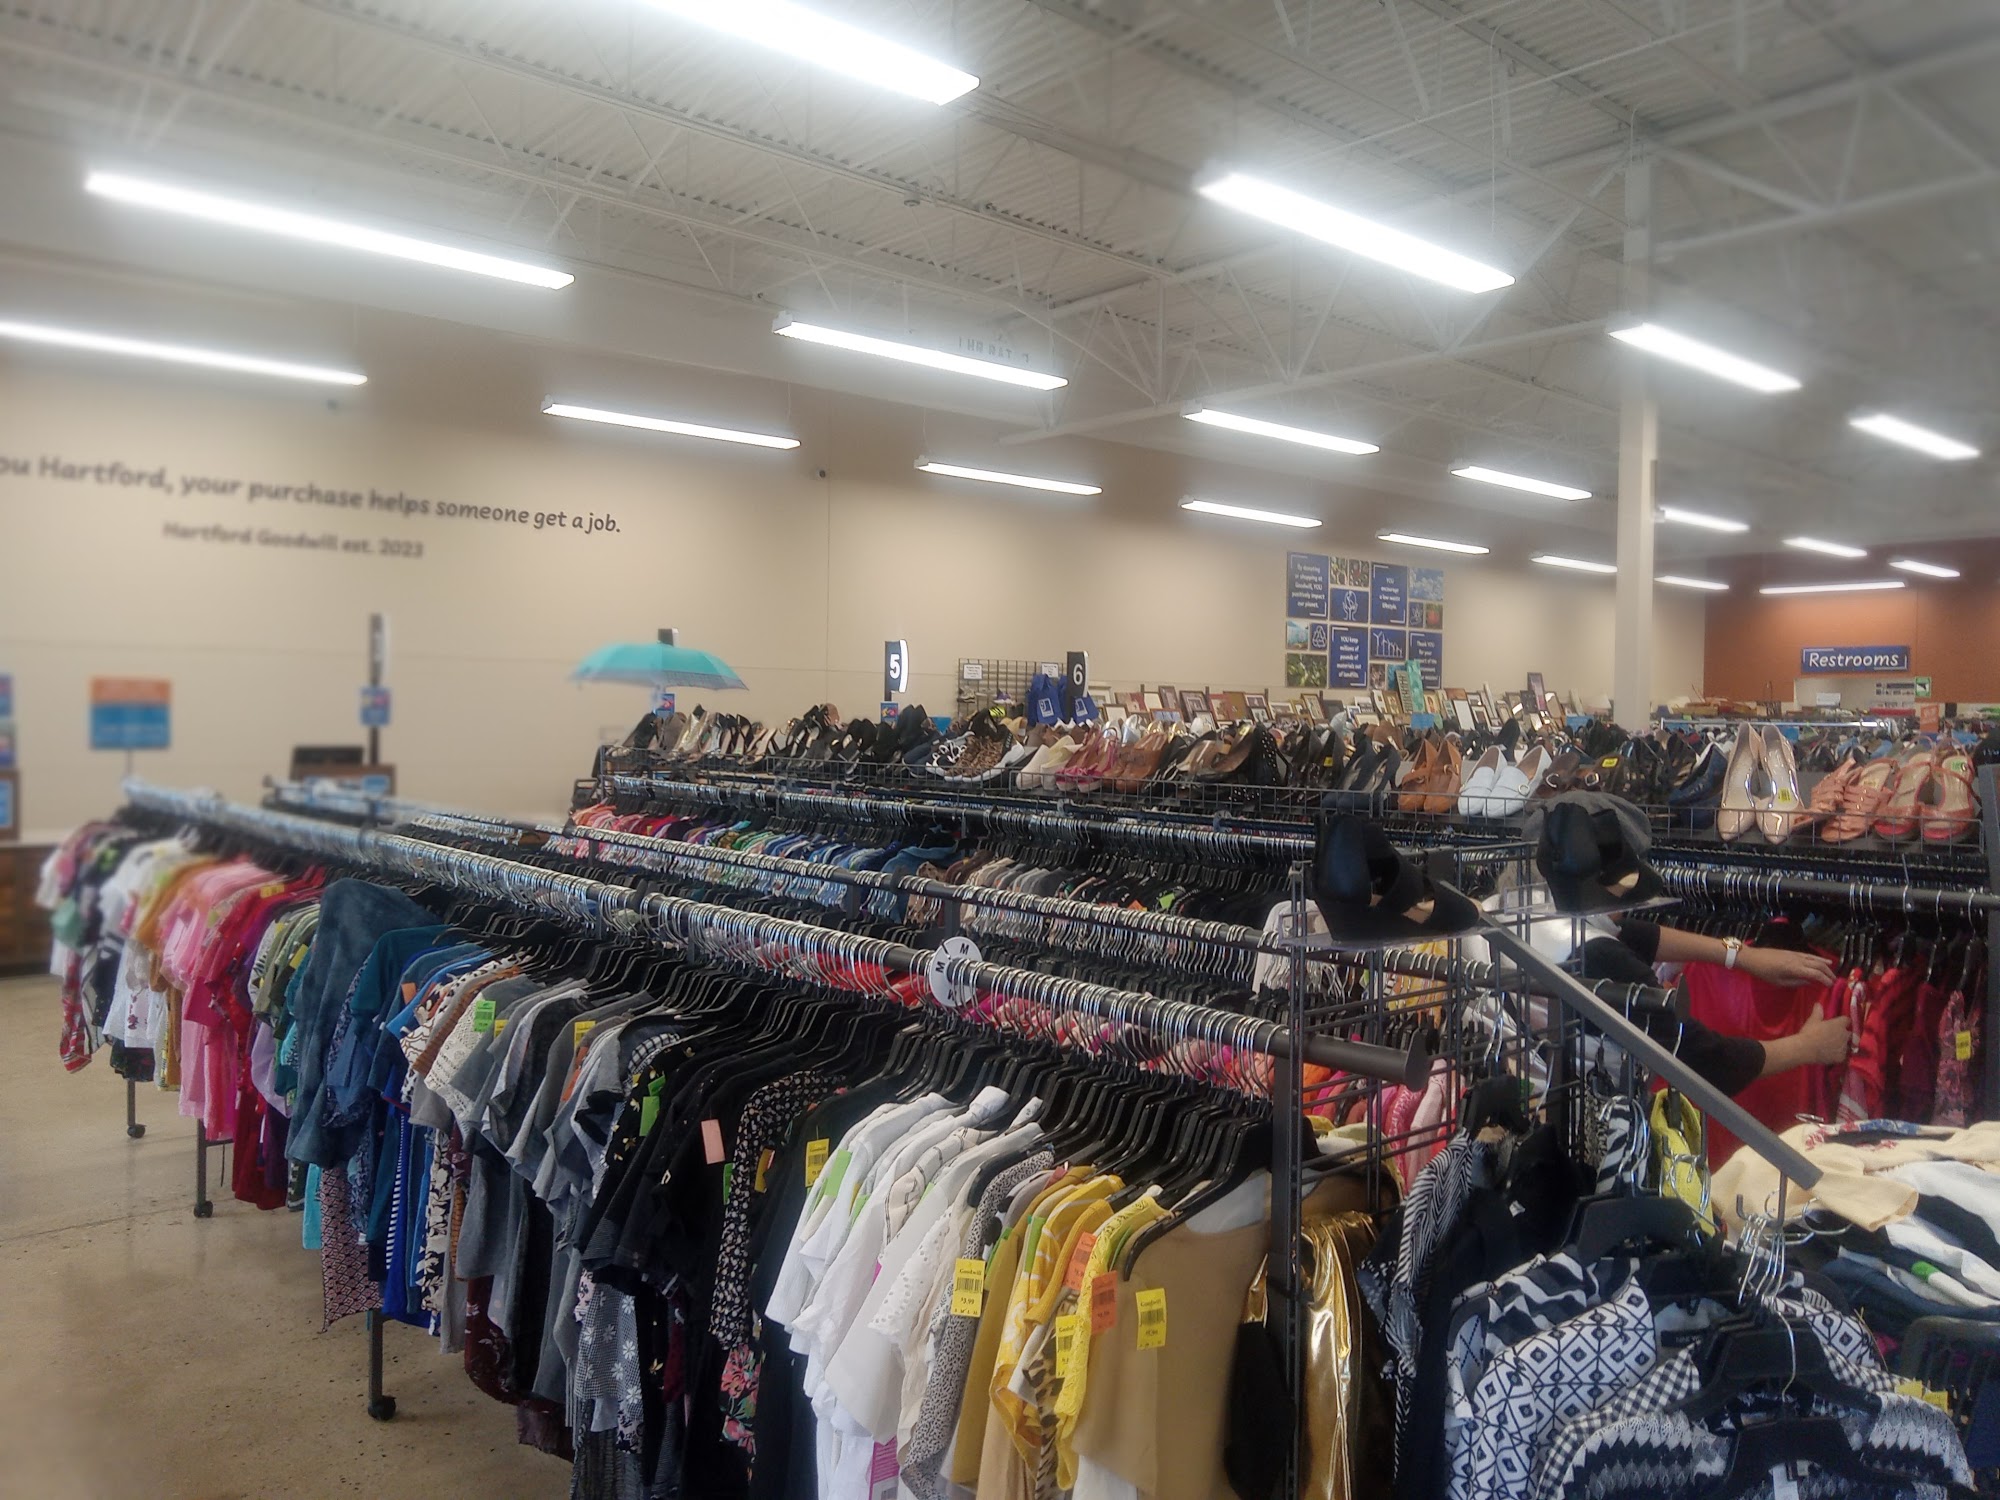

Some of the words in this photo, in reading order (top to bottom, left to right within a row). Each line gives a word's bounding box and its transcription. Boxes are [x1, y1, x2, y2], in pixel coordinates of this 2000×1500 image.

[39, 456, 174, 495] Hartford,
[181, 474, 241, 497] your
[248, 481, 363, 509] purchase
[369, 487, 430, 516] helps
[436, 500, 530, 524] someone
[533, 511, 567, 530] get
[572, 515, 584, 529] a
[584, 512, 621, 534] job.
[162, 521, 251, 545] Hartford
[256, 528, 338, 551] Goodwill
[890, 653, 900, 679] 5
[1809, 652, 1900, 668] Restrooms
[1073, 663, 1083, 686] 6
[960, 942, 970, 955] M
[935, 960, 946, 974] M
